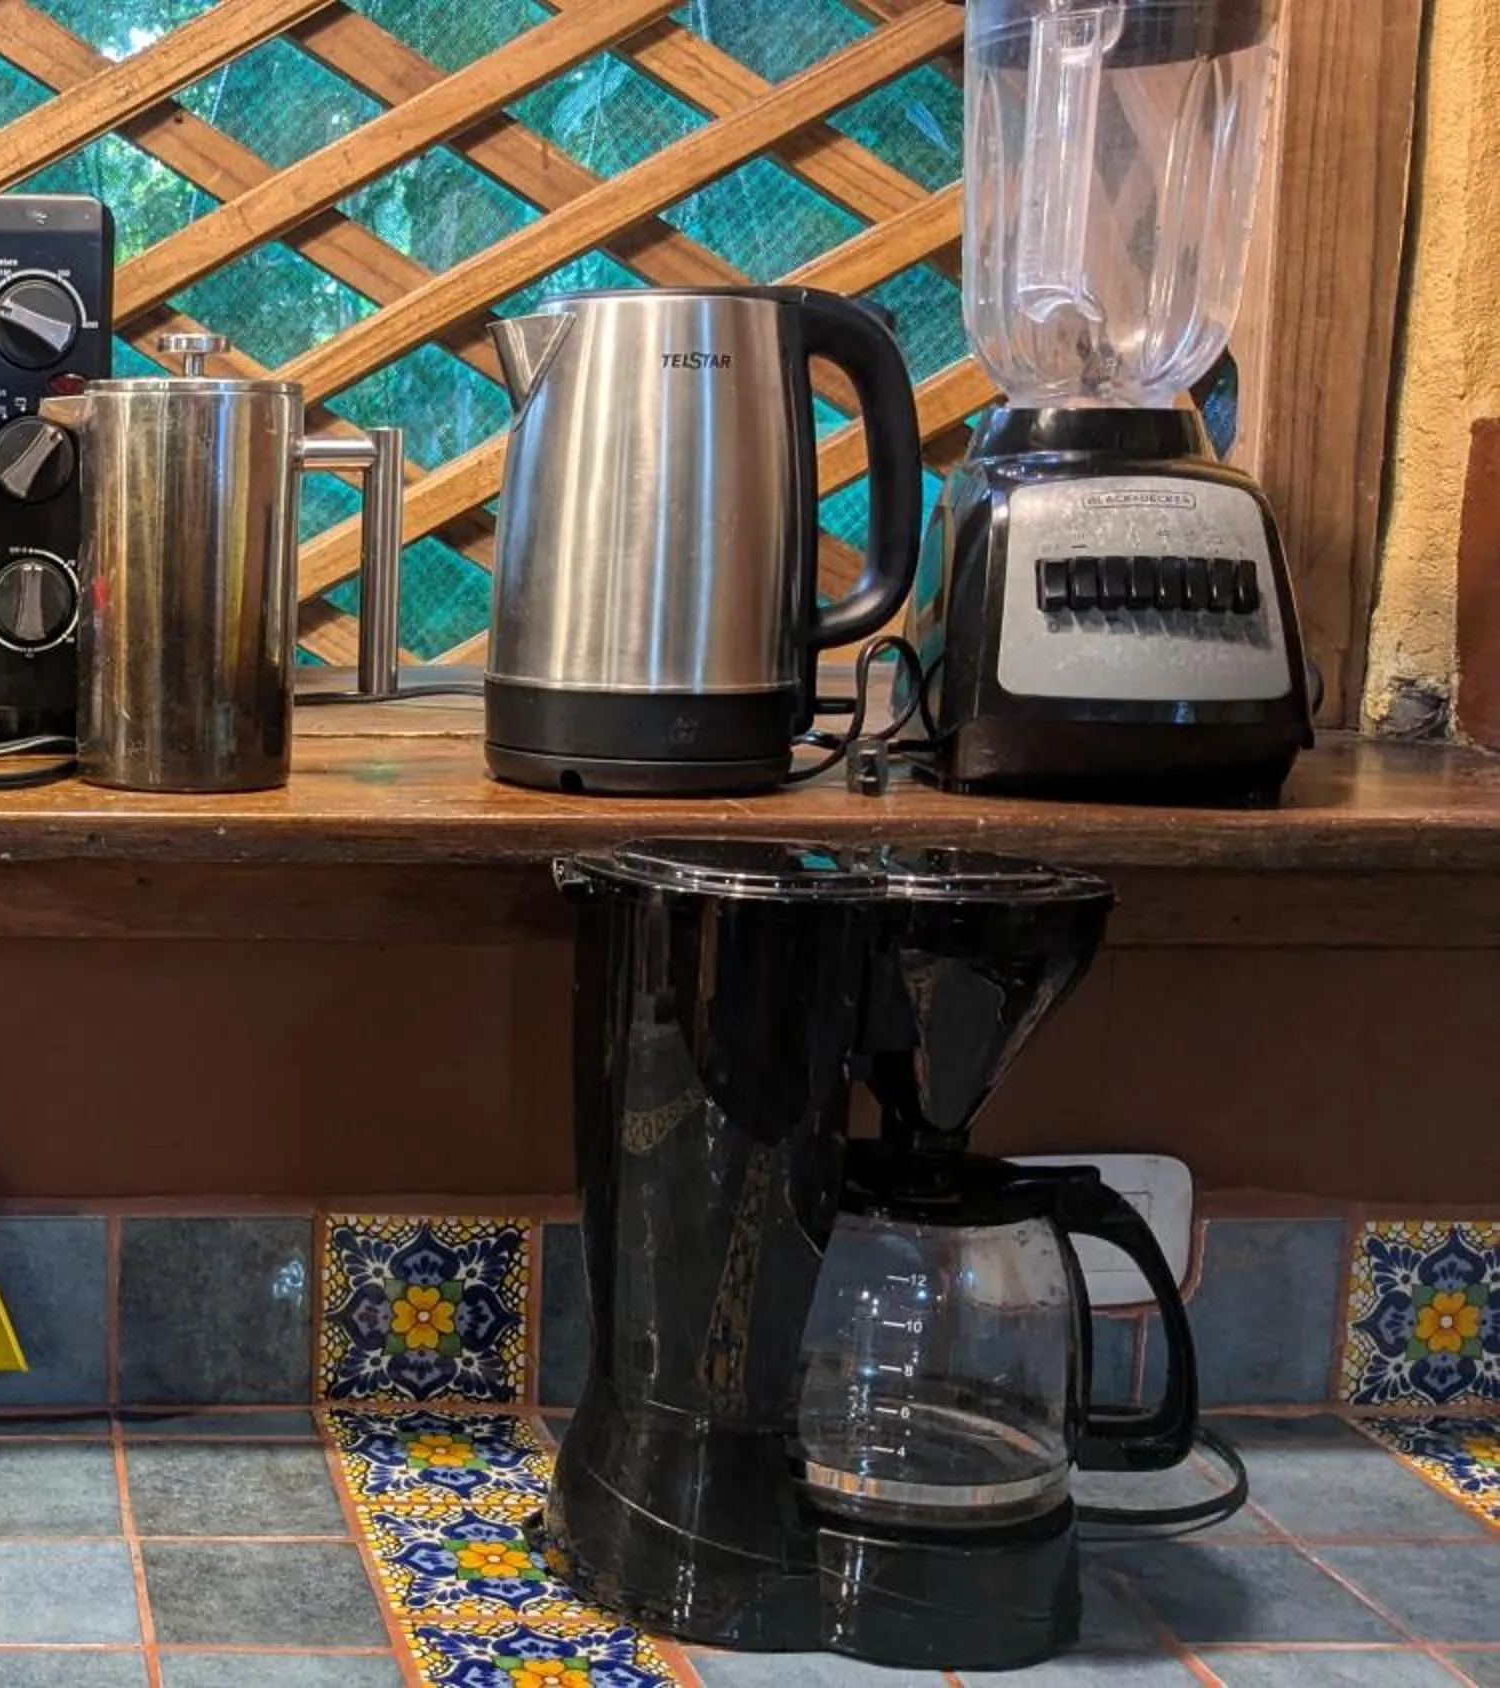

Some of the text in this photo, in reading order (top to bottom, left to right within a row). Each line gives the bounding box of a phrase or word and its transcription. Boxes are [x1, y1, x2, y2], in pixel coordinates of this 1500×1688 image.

[661, 351, 732, 369] TELSTAR
[911, 1273, 927, 1287] 12
[907, 1320, 923, 1333] 10
[904, 1363, 913, 1377] 8
[901, 1406, 910, 1420] 6
[897, 1445, 905, 1458] 4
